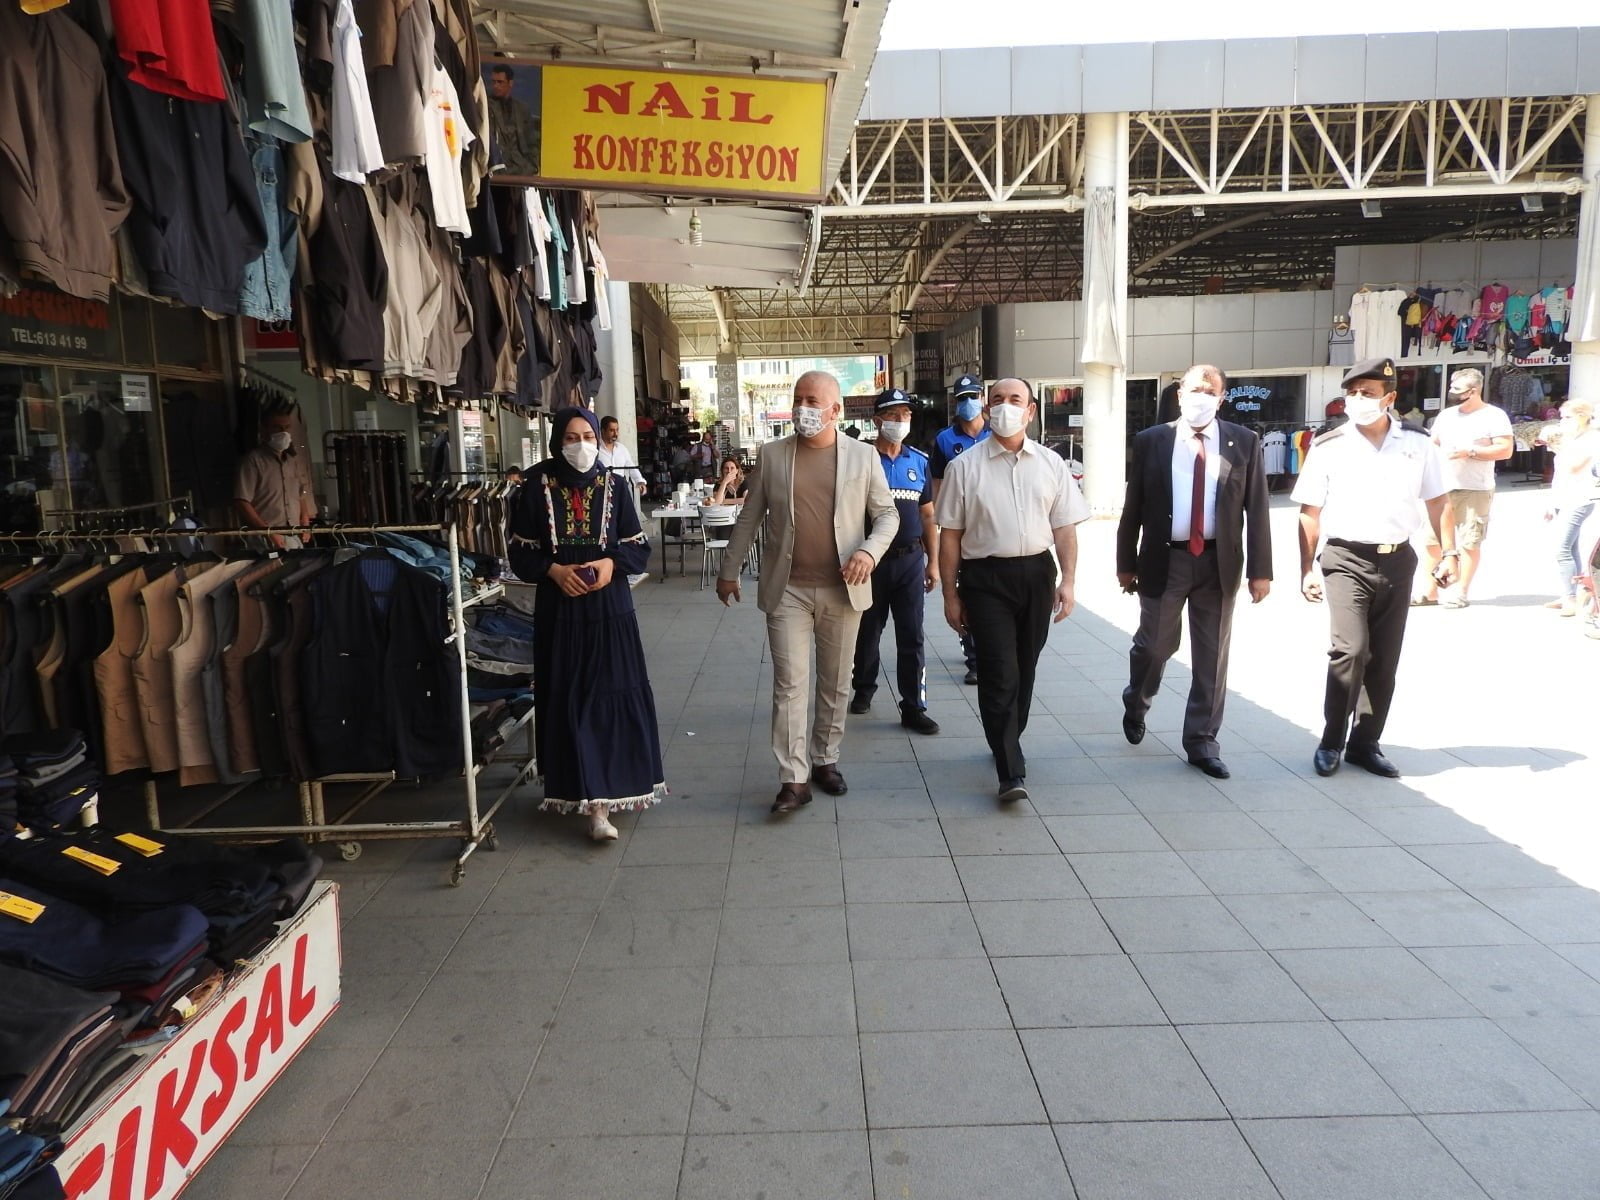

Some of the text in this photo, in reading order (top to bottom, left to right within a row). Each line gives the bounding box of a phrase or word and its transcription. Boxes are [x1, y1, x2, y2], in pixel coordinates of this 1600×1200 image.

[11, 327, 87, 349] TEL:613 41 99
